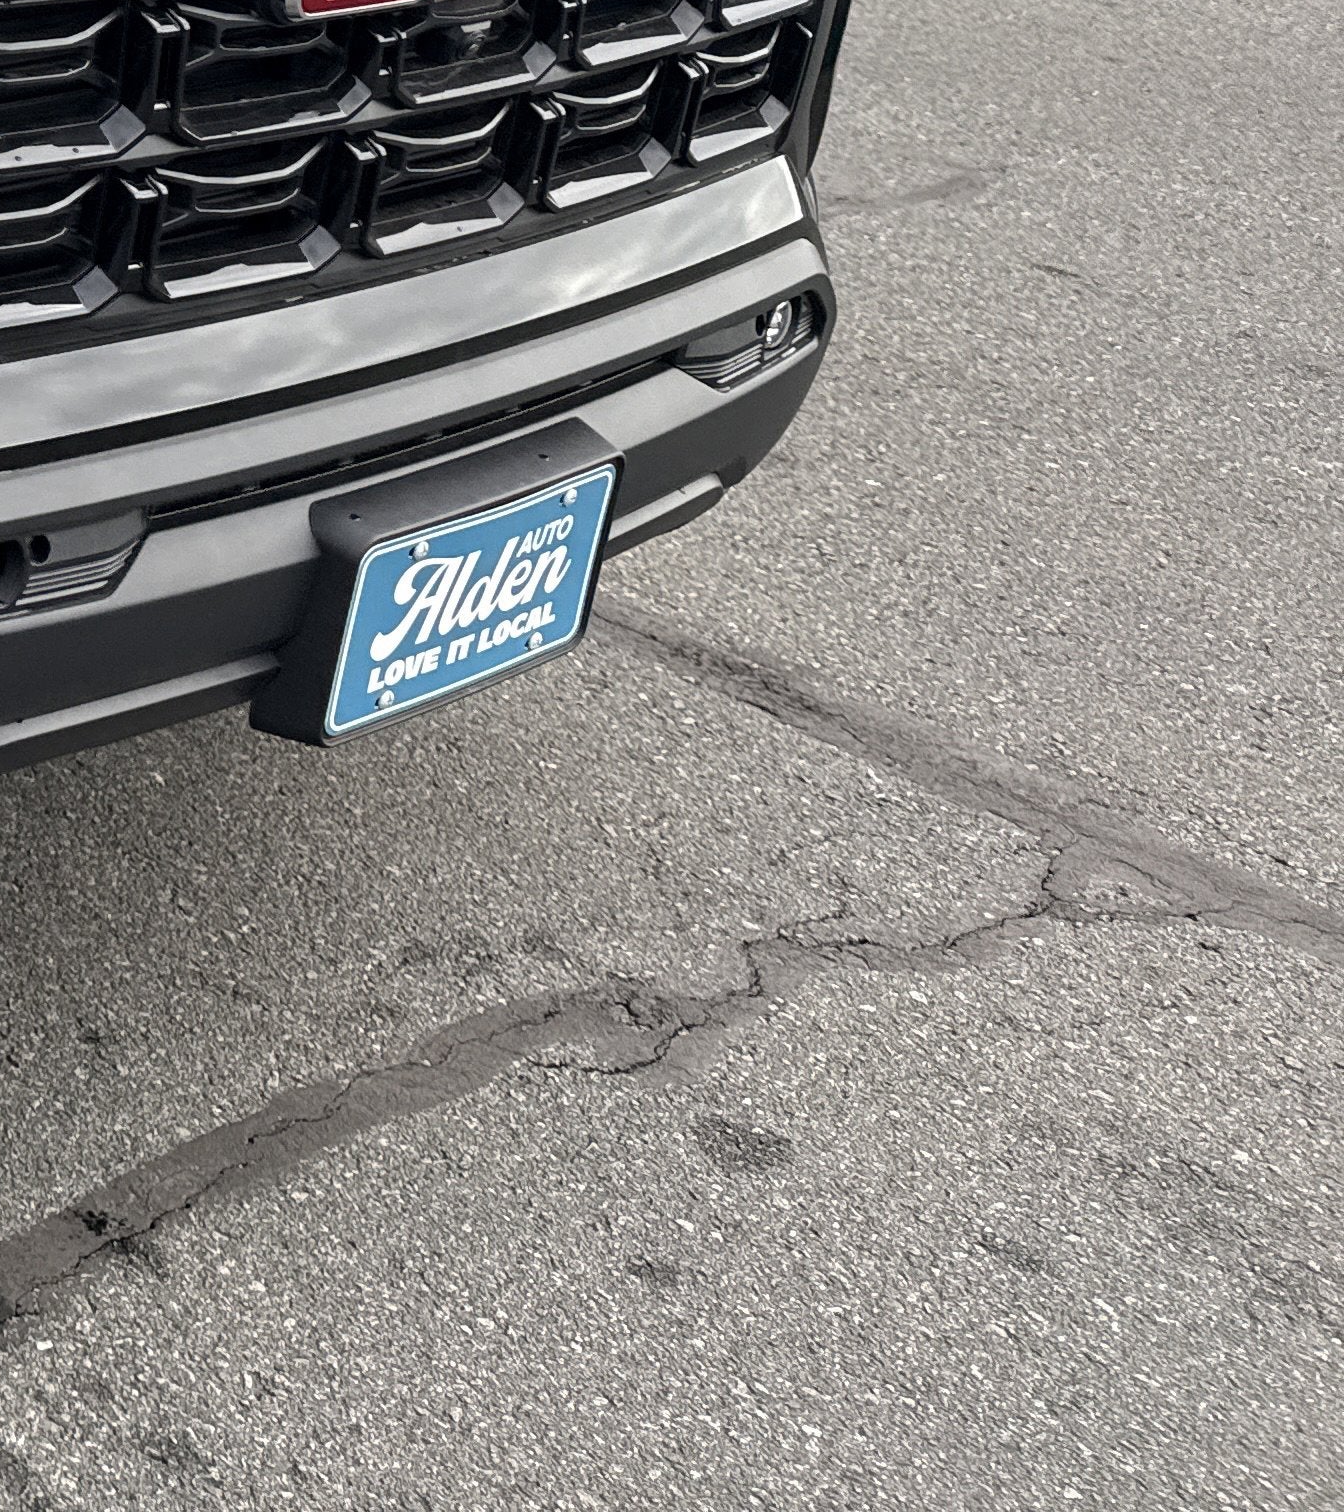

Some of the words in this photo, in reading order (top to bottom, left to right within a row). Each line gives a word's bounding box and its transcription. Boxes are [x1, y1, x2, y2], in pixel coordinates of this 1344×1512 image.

[516, 514, 574, 558] AUTO
[369, 535, 572, 661] Alden
[367, 646, 441, 694] LOVE
[446, 634, 476, 665] IT
[476, 601, 556, 653] LOCAL
